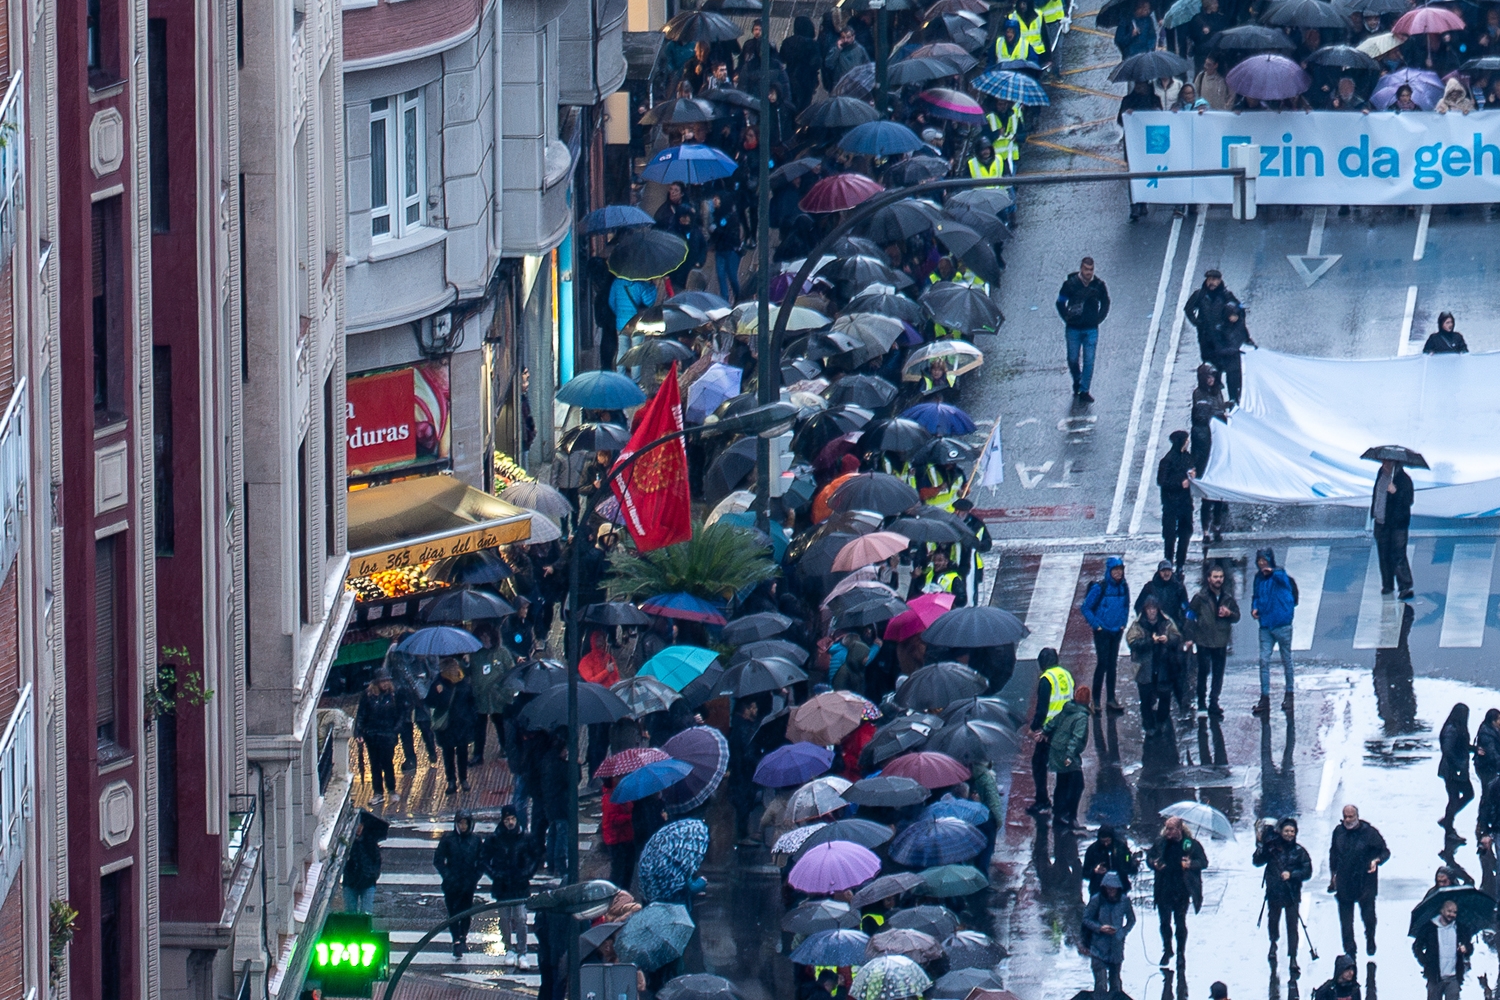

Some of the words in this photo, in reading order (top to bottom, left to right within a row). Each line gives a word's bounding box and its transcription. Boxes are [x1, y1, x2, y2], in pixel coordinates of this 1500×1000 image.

[1337, 133, 1401, 178] da
[360, 560, 378, 575] los
[386, 550, 410, 569] 365
[451, 536, 471, 554] del
[477, 533, 498, 548] año
